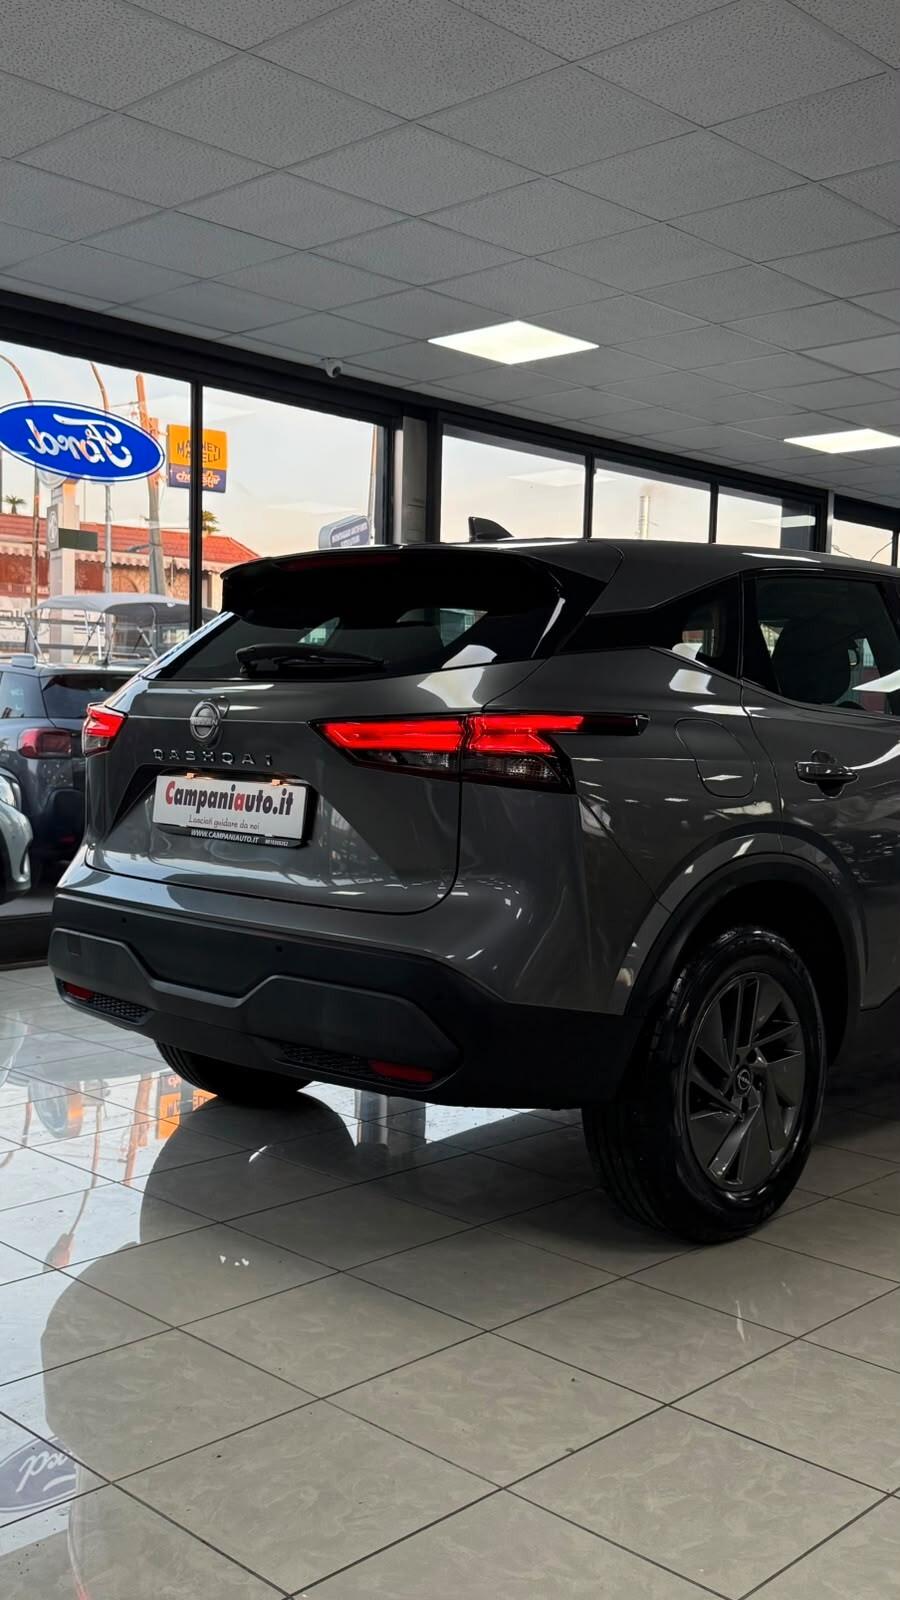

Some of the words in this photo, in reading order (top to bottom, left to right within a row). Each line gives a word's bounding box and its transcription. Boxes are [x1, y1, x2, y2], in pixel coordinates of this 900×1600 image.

[153, 748, 273, 767] QASHQAI
[165, 780, 294, 816] Campaniauto.it
[213, 817, 238, 829] guidare
[239, 819, 248, 830] da
[249, 822, 260, 832] noi
[190, 829, 260, 844] WWW.CAMPANIAUTO.IT
